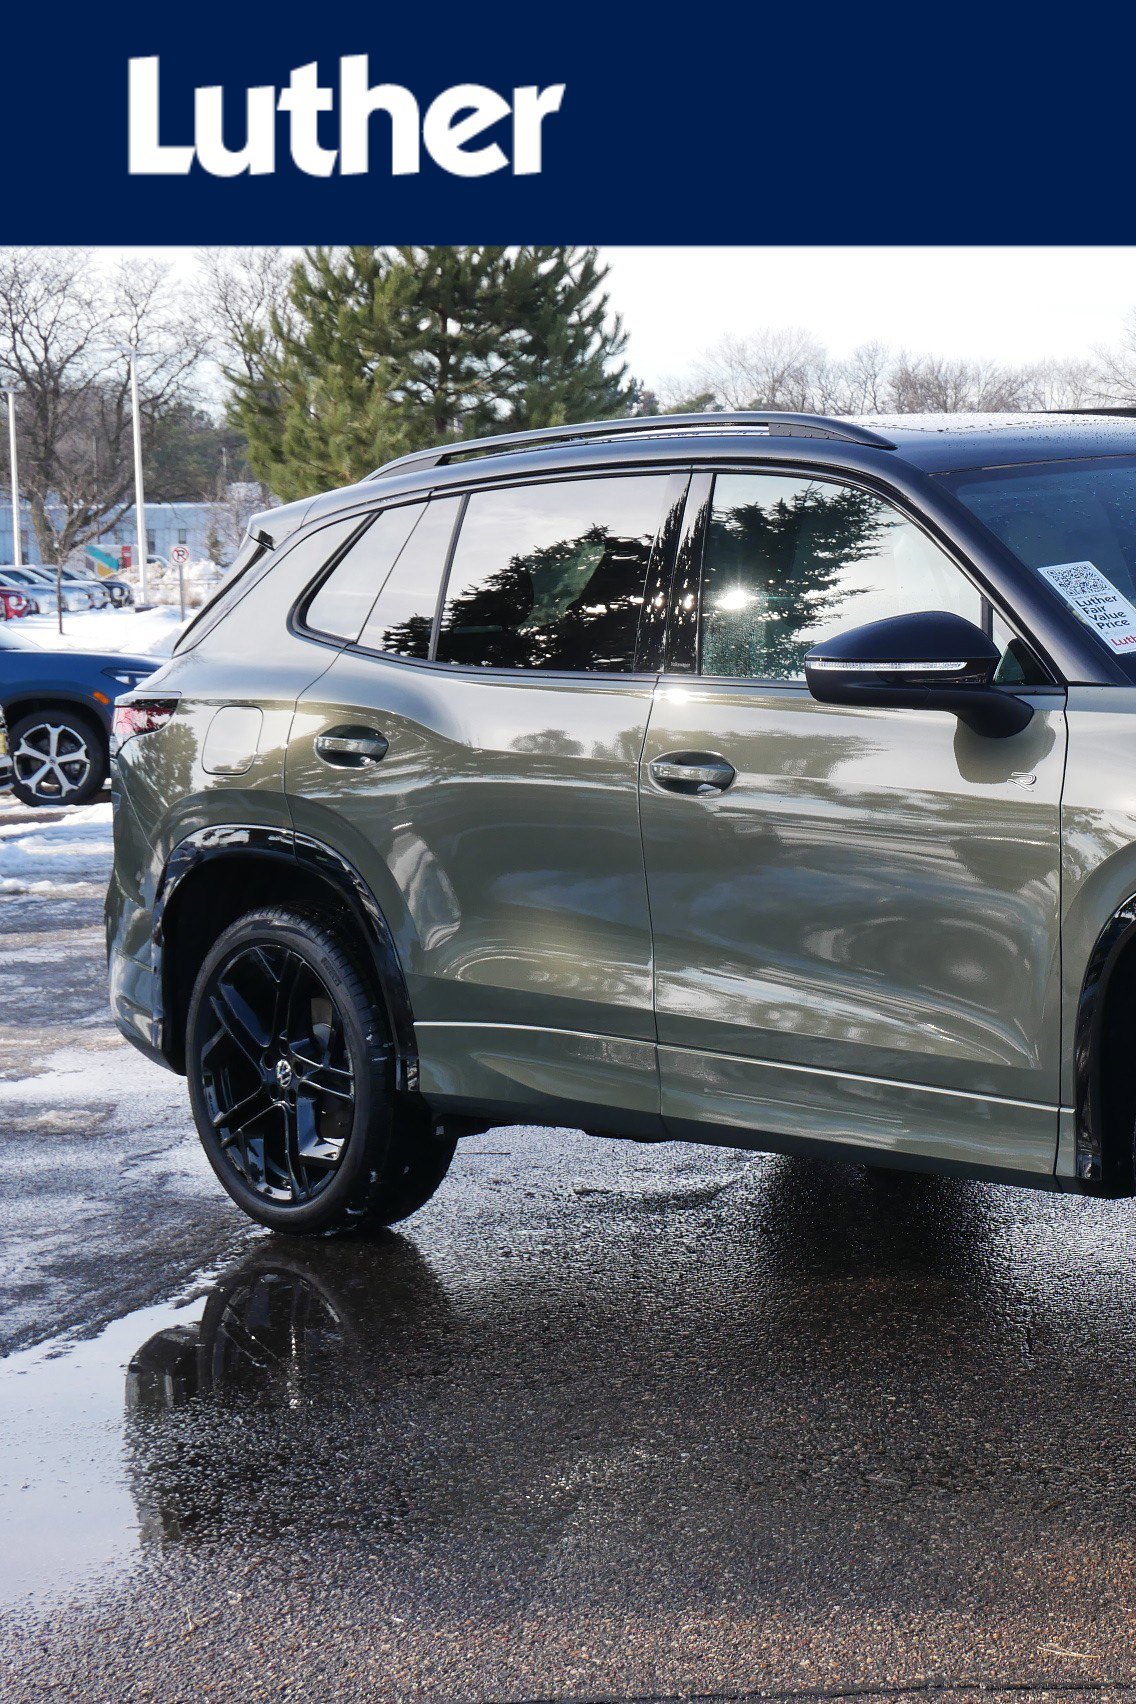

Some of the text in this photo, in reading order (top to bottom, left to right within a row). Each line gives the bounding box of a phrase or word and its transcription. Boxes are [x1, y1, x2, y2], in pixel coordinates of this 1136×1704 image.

[1075, 594, 1118, 608] Luther
[1083, 604, 1107, 615] Fair
[1088, 611, 1127, 622] Value
[1095, 619, 1131, 630] Price
